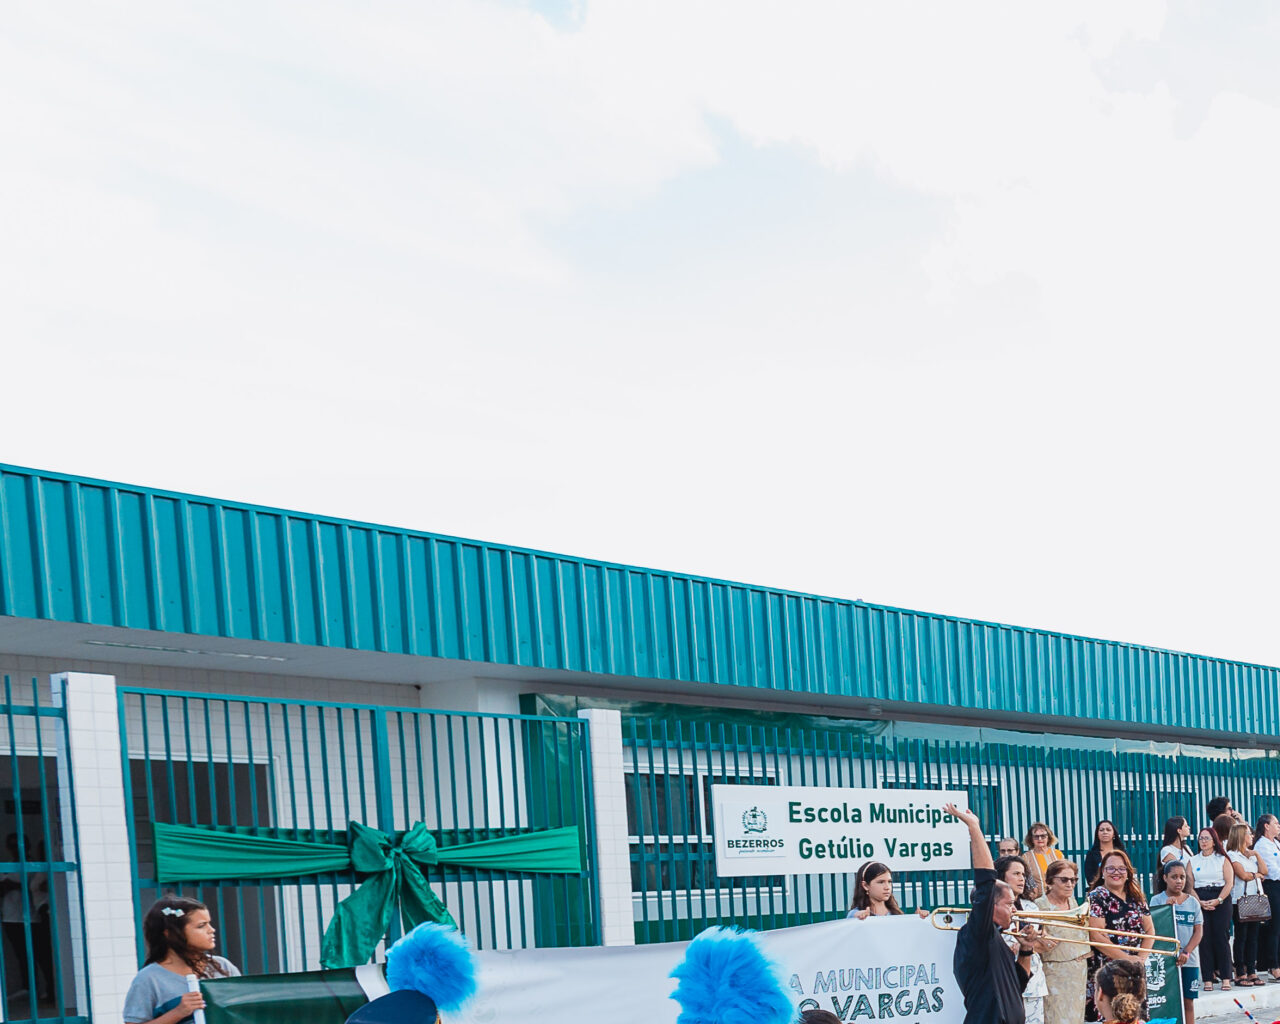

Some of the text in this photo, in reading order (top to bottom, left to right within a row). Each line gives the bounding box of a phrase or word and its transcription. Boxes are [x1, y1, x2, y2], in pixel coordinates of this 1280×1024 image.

[788, 801, 862, 824] Escola
[727, 839, 785, 849] BEZERROS
[798, 836, 954, 862] Getúlio Vargas
[813, 963, 940, 994] MUNICIPAL
[831, 986, 945, 1021] VARGAS
